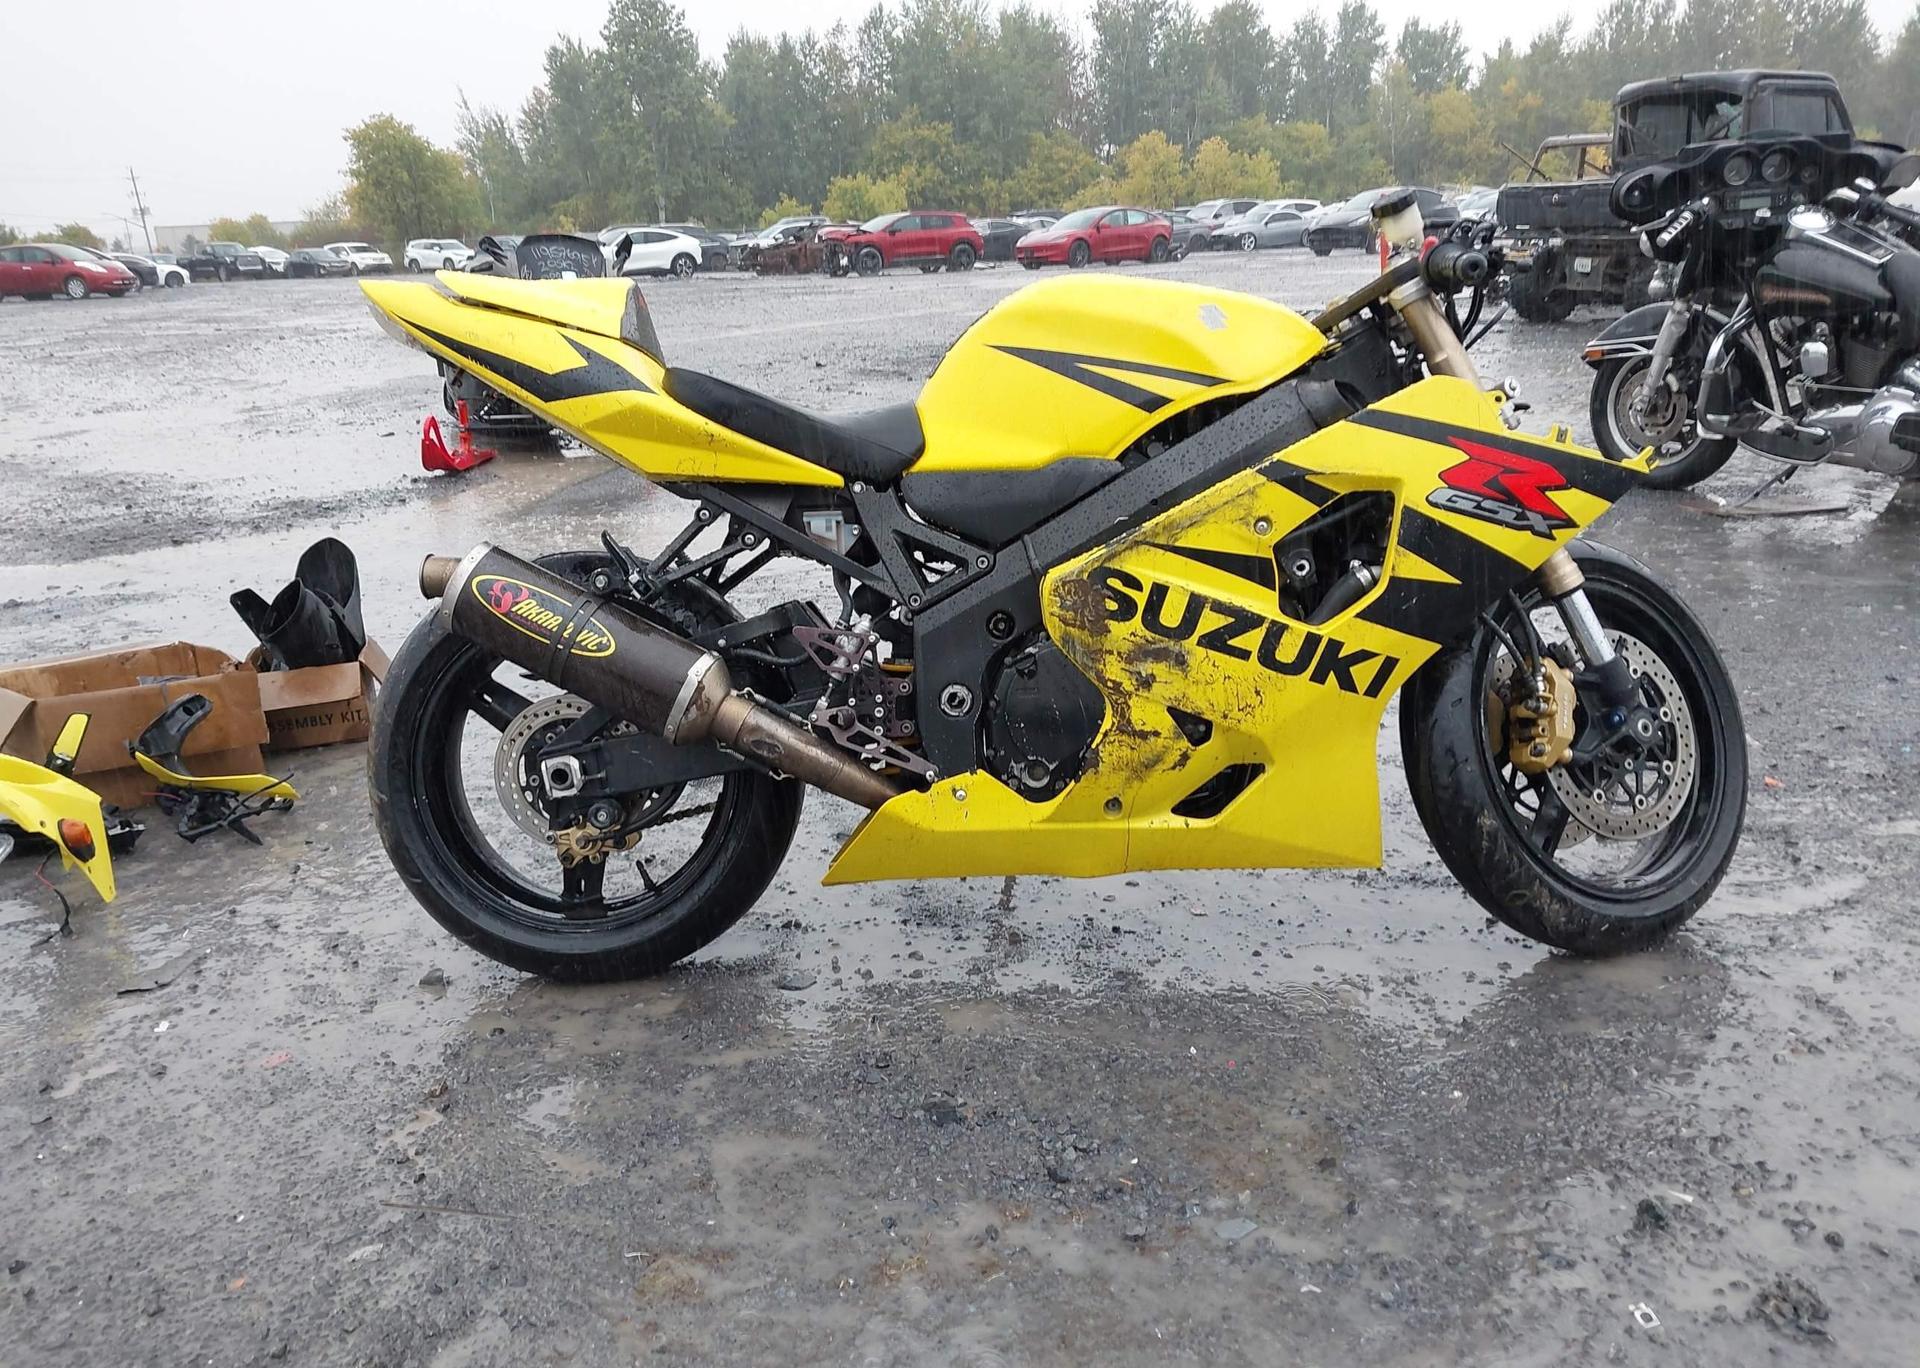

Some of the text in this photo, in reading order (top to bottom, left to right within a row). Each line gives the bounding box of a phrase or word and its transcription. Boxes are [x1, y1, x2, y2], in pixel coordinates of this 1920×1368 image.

[1425, 487, 1566, 541] GSX
[1085, 566, 1400, 699] SUZUKI
[341, 710, 362, 723] KIT
